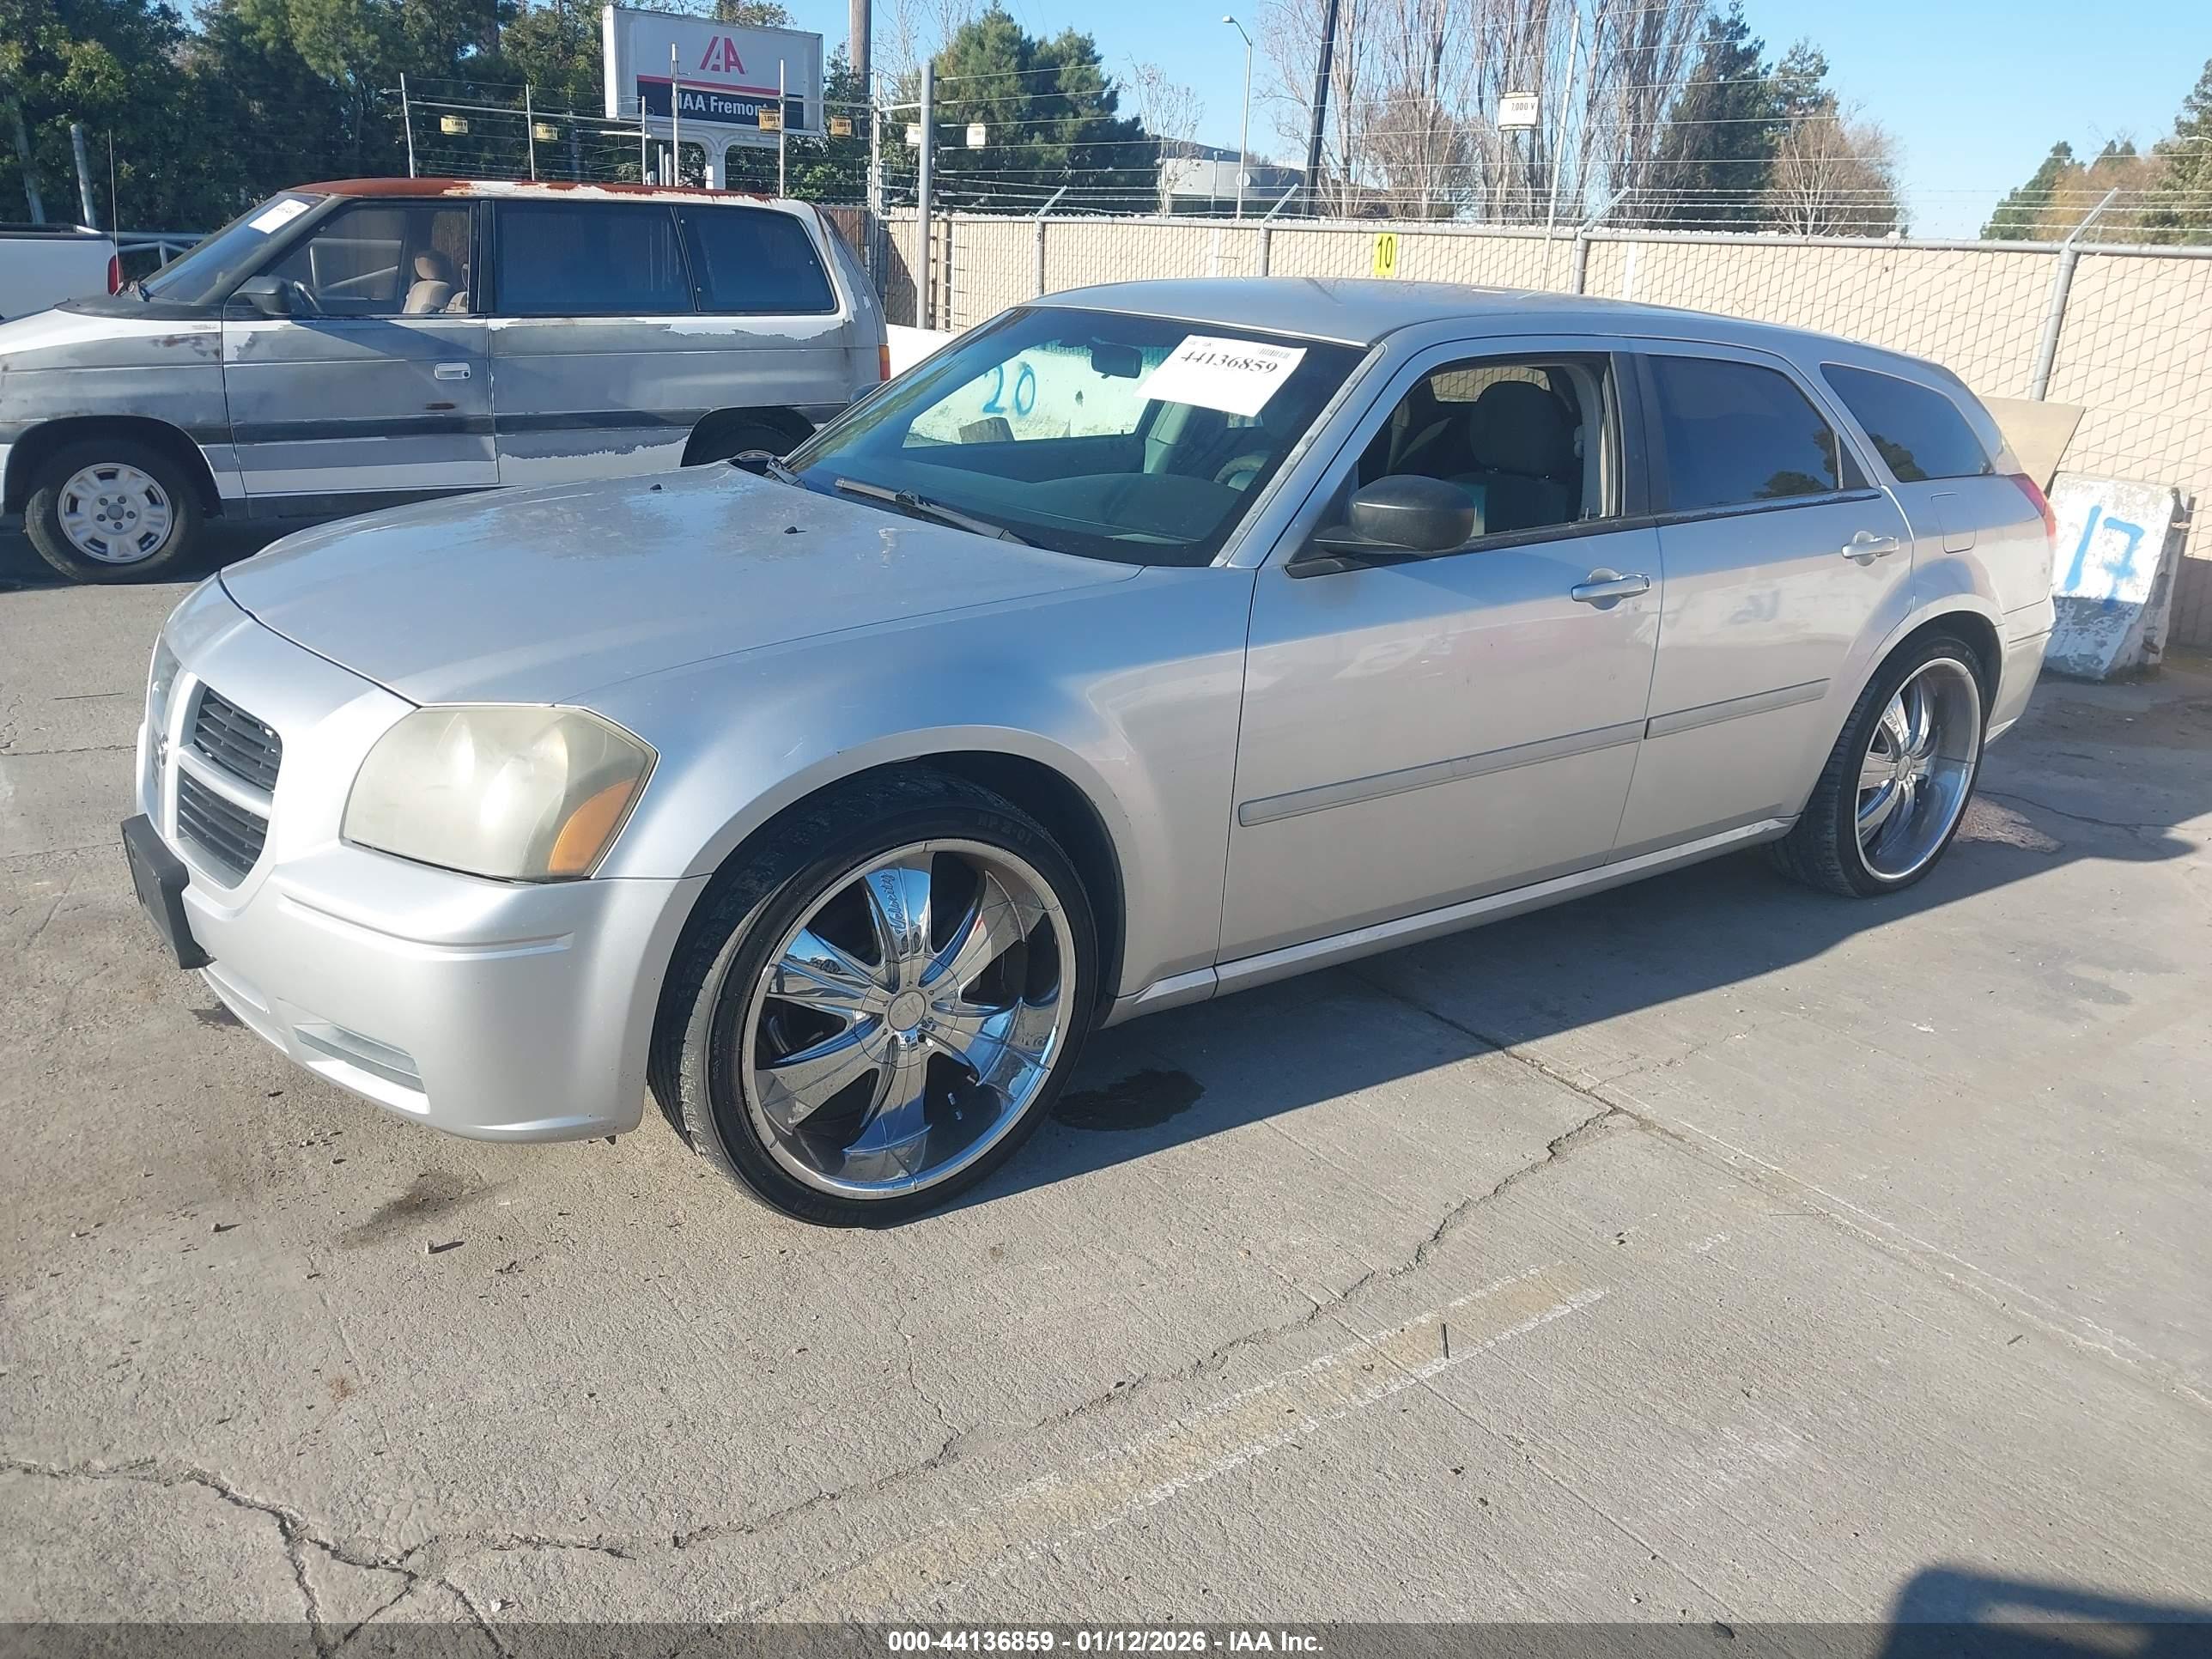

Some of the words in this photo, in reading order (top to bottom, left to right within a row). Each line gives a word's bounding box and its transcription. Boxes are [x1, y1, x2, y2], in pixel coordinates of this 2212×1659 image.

[678, 93, 706, 112] IAA
[1377, 235, 1394, 269] 10
[1181, 350, 1279, 374] 44136859
[981, 362, 1036, 416] 20
[2063, 505, 2145, 611] 17
